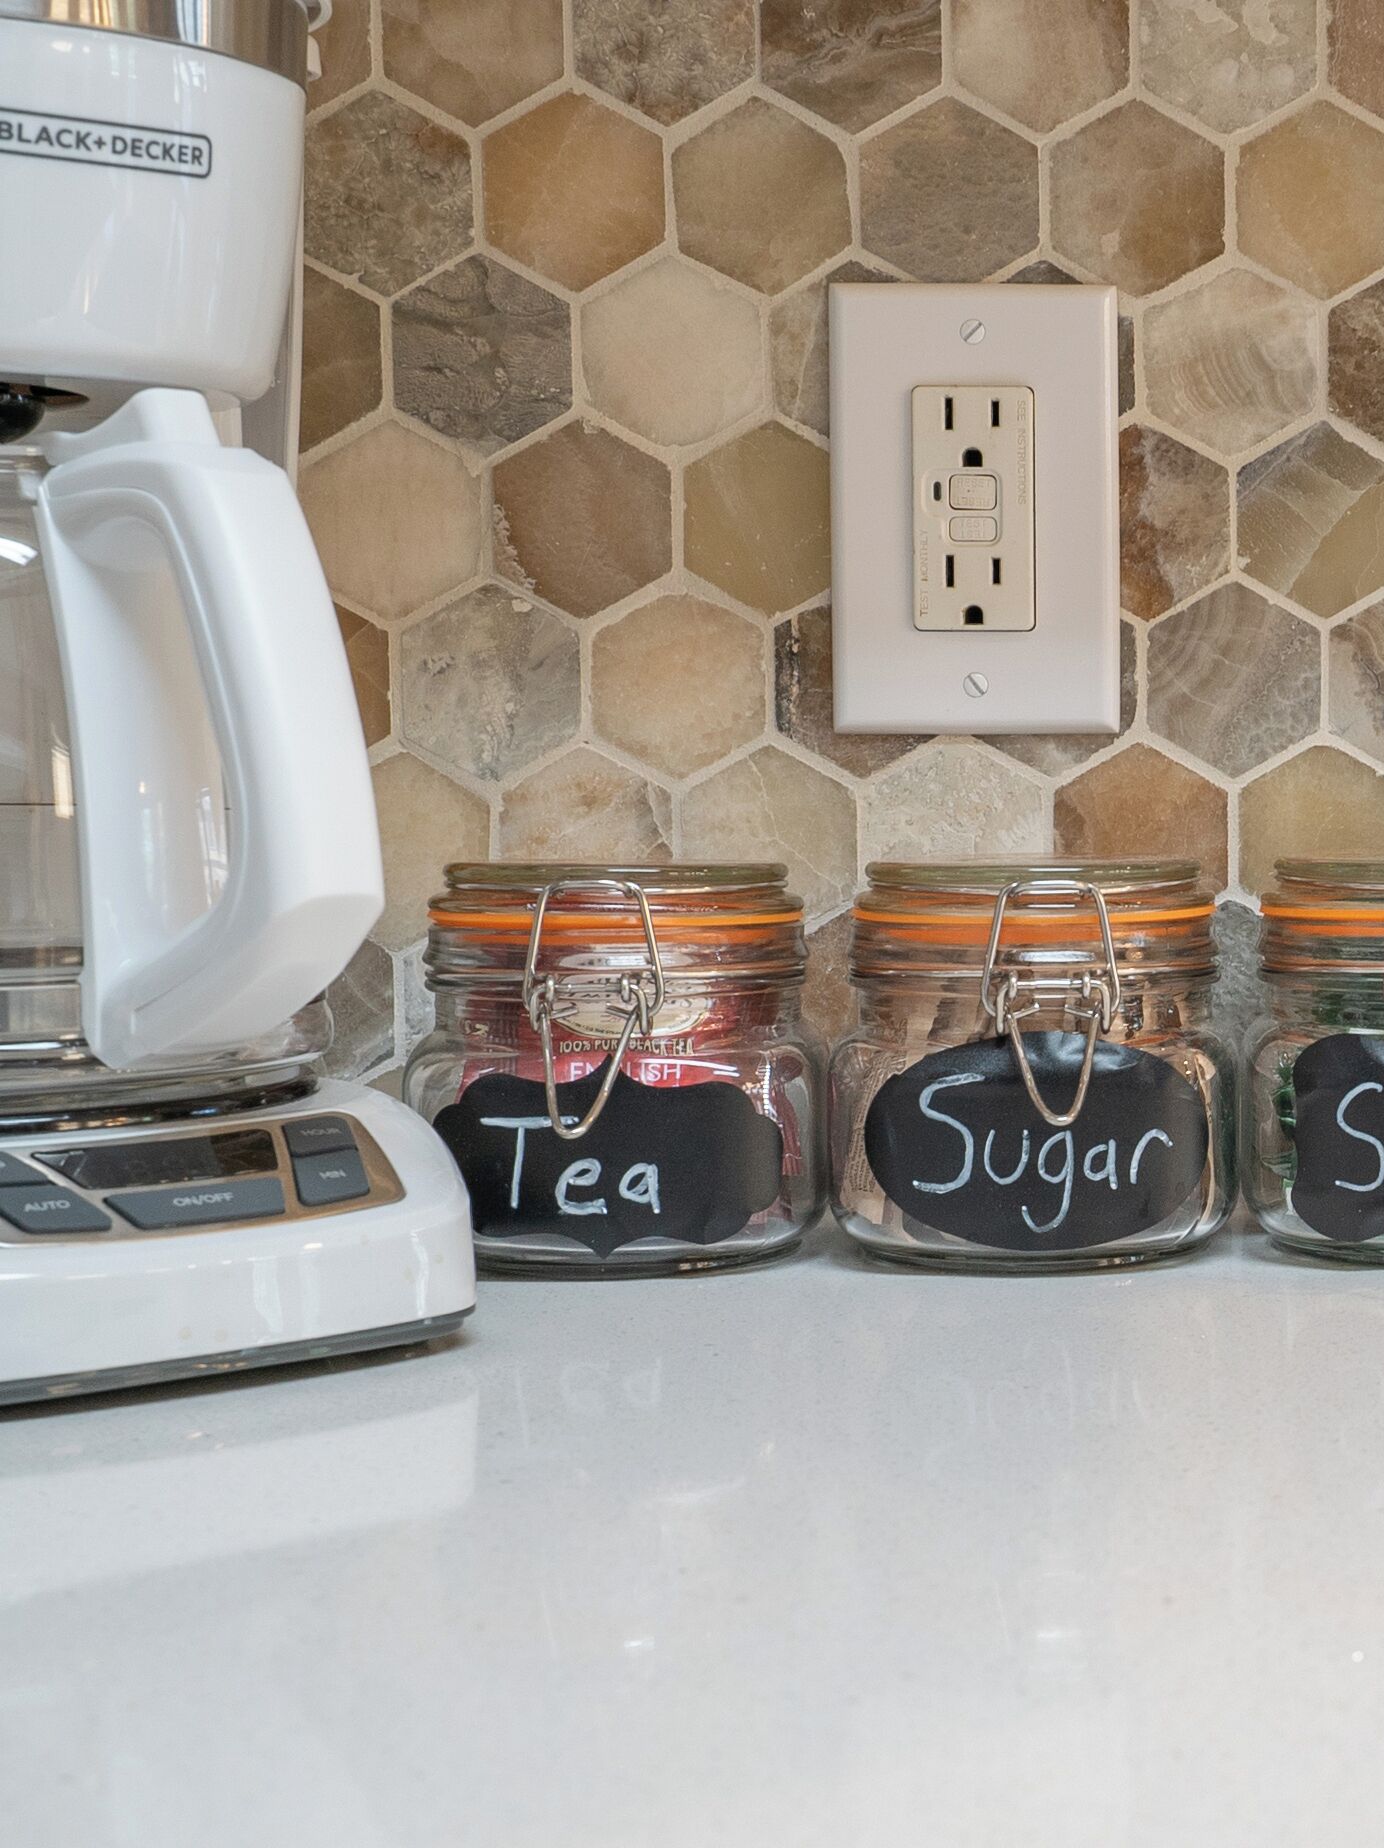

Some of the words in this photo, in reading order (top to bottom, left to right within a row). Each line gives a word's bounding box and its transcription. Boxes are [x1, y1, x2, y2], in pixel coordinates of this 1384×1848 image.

[0, 120, 203, 166] BLACK+DECKER
[1017, 400, 1026, 422] SEE
[1017, 428, 1027, 505] INSTRUCTIONS
[921, 530, 929, 582] MONTHLY
[920, 589, 929, 617] TEST
[560, 1040, 591, 1053] 100%
[594, 1039, 621, 1051] PUR
[671, 1038, 696, 1056] TEA
[301, 1127, 342, 1137] HOUR
[479, 1116, 661, 1215] Tea
[912, 1072, 1174, 1234] Sugar
[319, 1169, 347, 1181] MIN
[24, 1199, 71, 1213] AUTO
[173, 1191, 235, 1208] ON/OFF
